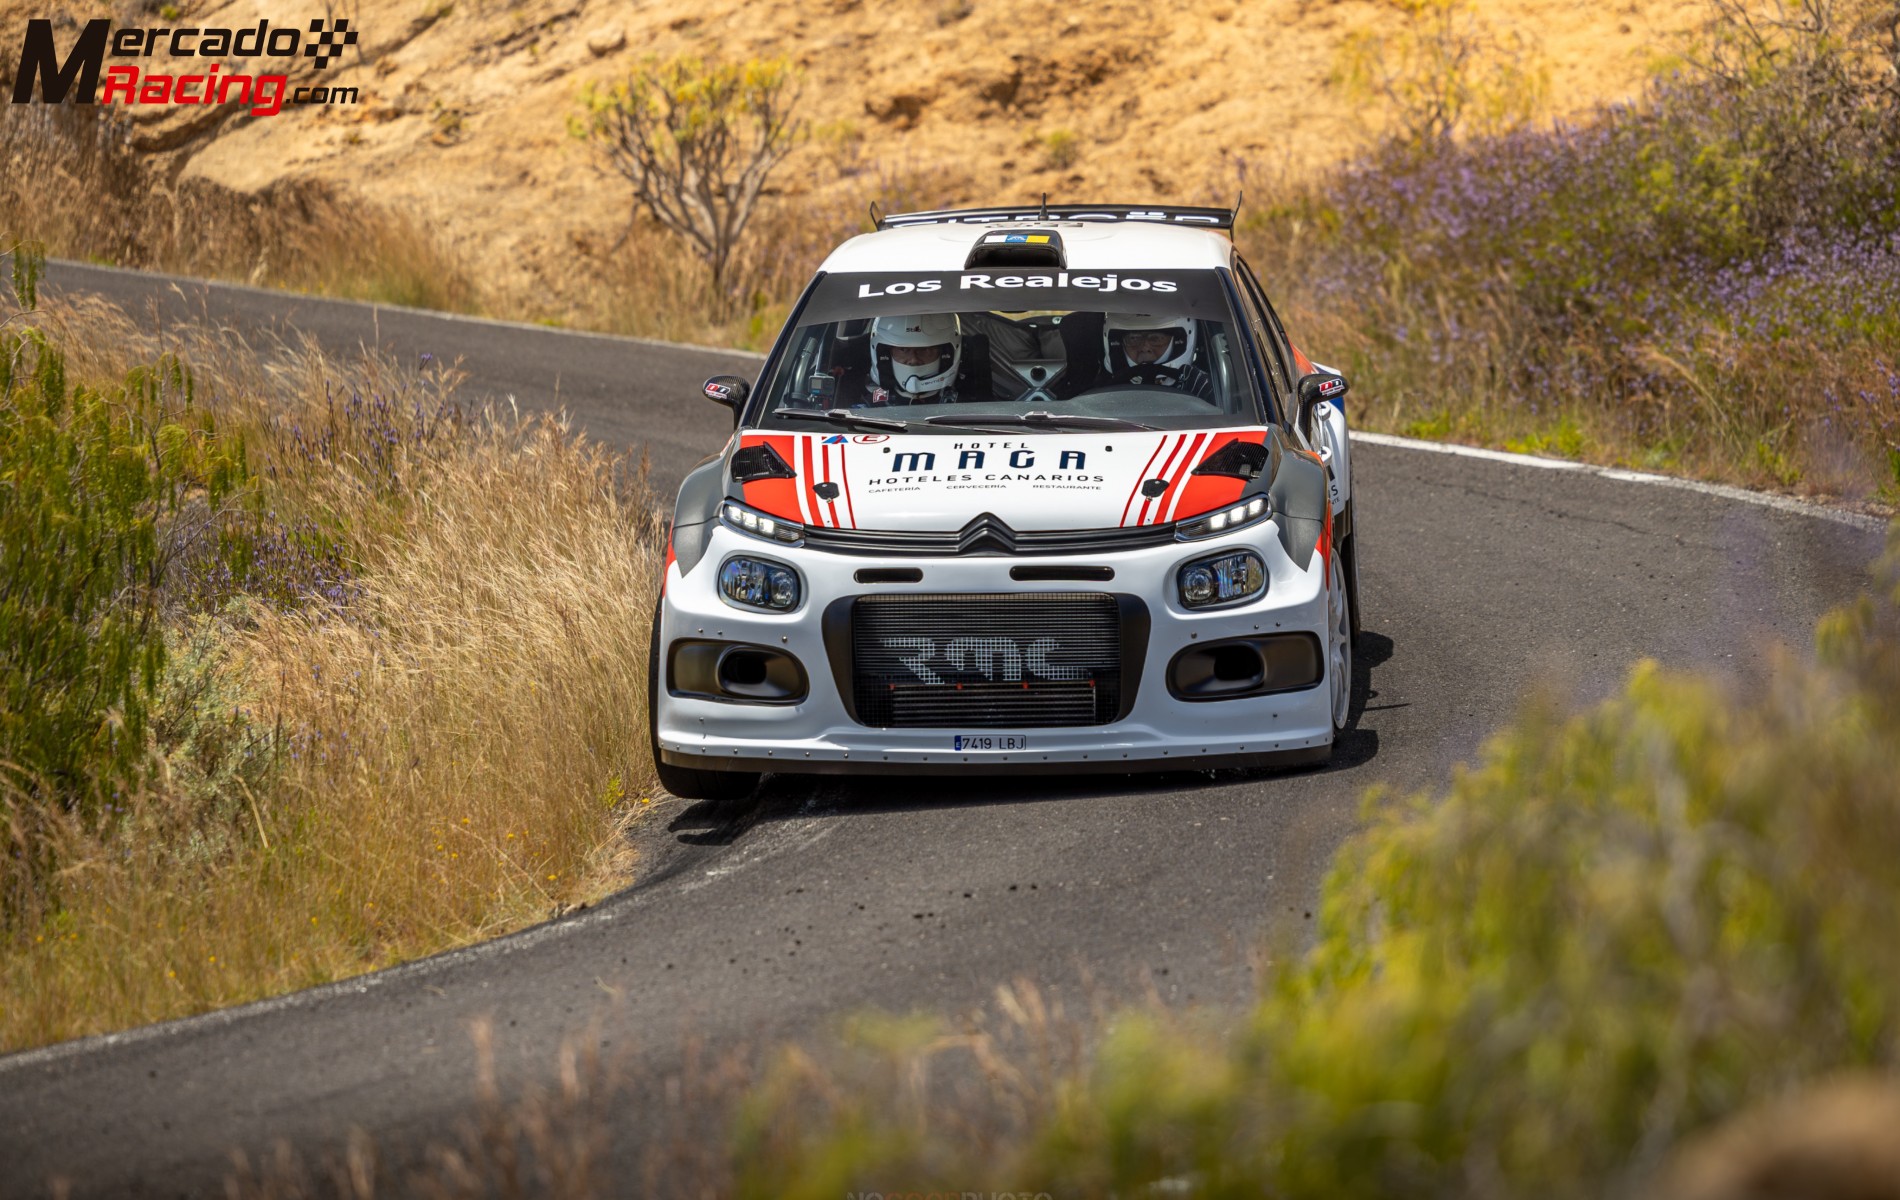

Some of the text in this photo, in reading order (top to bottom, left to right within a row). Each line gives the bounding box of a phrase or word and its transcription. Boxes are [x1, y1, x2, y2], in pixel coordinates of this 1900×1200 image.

[858, 272, 1178, 298] Los Realejos
[953, 442, 1029, 450] HOTEL
[892, 449, 1086, 473] MAGA
[868, 474, 1104, 486] HOTELES CANARIOS
[962, 737, 992, 750] 7419
[998, 737, 1024, 750] LBJ
